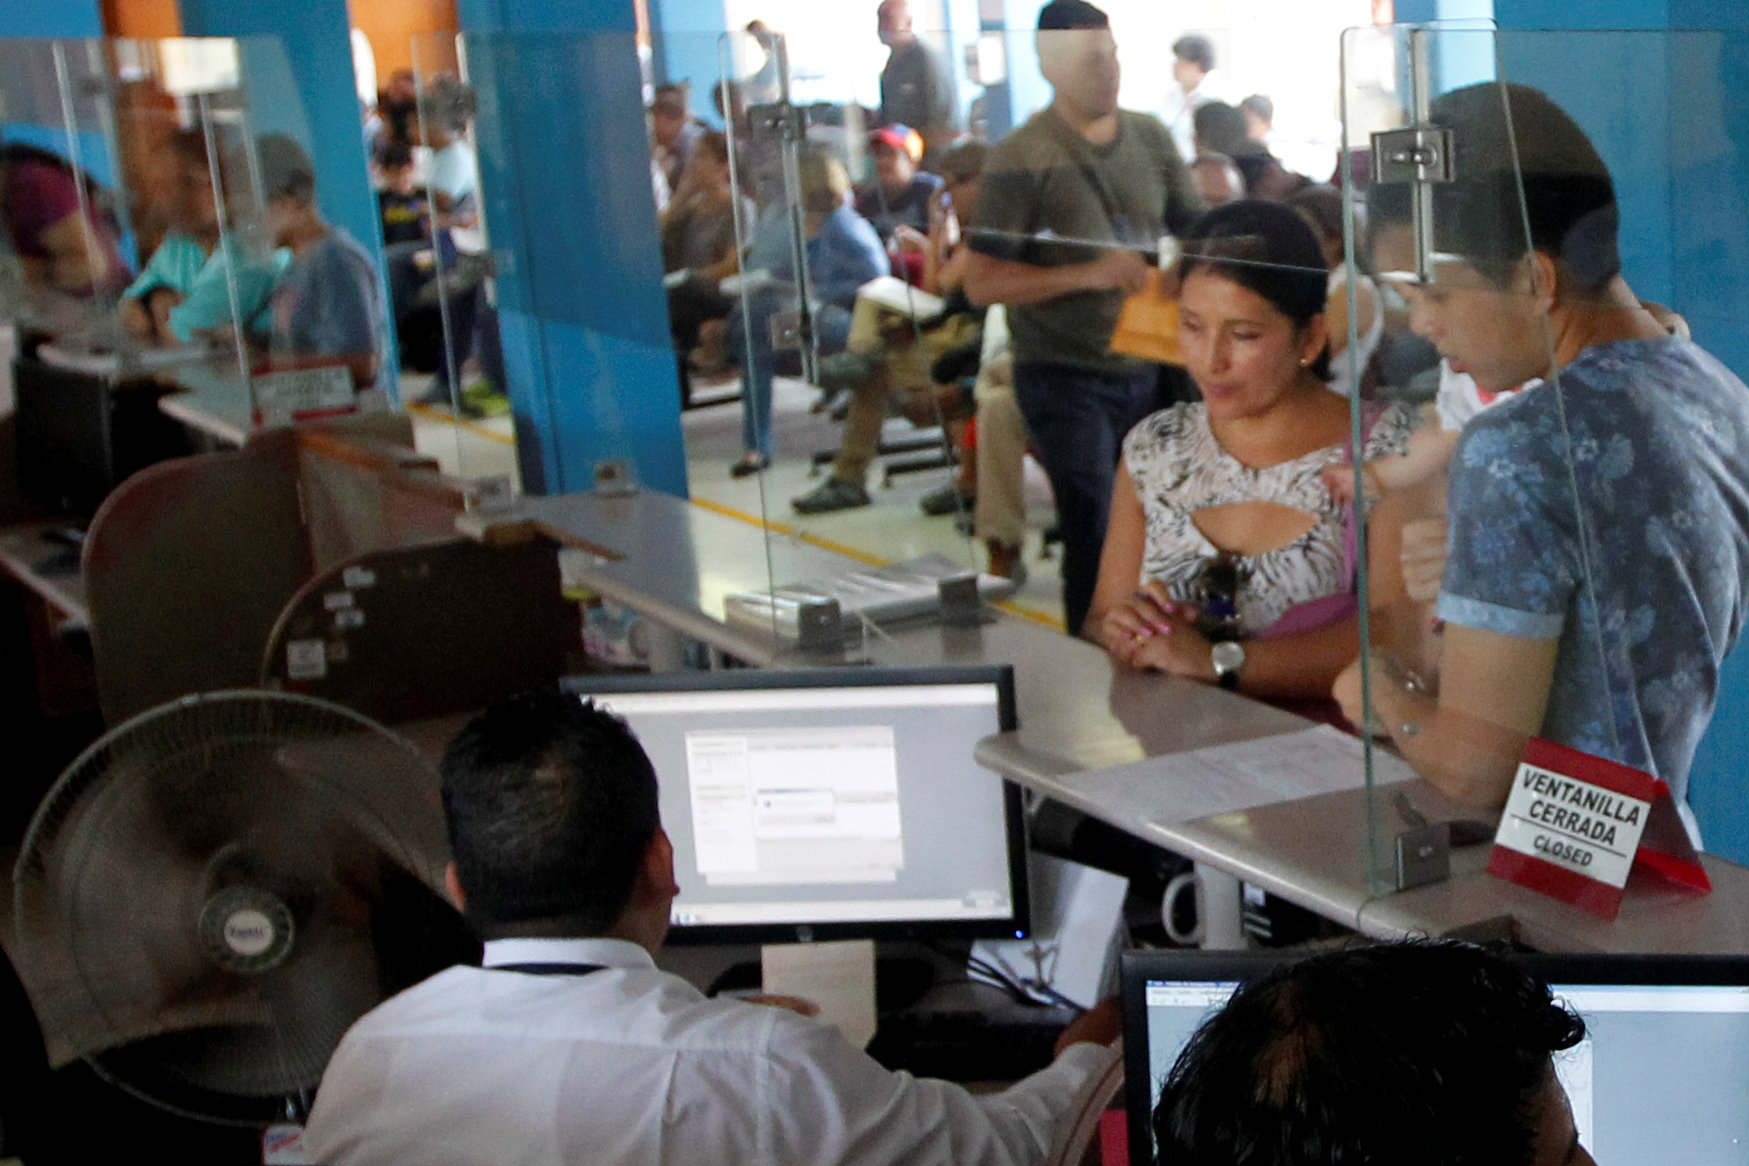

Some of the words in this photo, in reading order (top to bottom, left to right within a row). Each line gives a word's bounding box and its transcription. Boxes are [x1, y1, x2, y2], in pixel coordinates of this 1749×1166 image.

[1521, 769, 1640, 826] VENTANILLA
[1529, 800, 1617, 846] CERRADA
[1533, 835, 1594, 866] CLOSED
